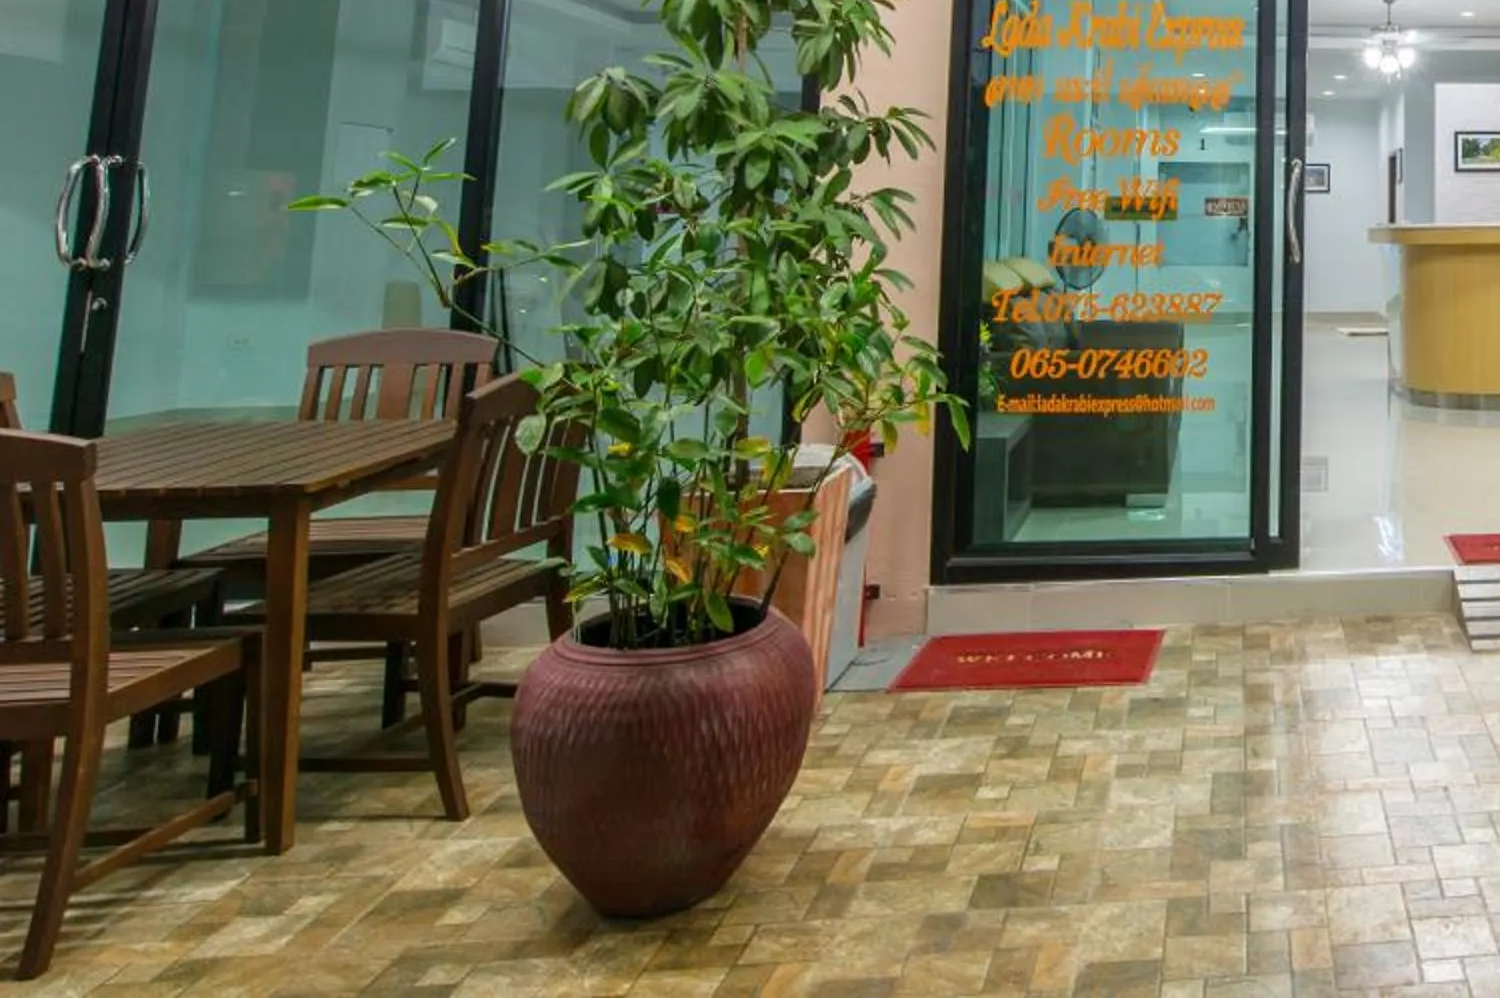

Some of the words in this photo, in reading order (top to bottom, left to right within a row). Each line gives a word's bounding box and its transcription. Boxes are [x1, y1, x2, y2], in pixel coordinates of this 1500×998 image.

[1042, 114, 1181, 164] Rooms
[1048, 233, 1167, 267] Internet
[1009, 346, 1210, 380] 065-0746602
